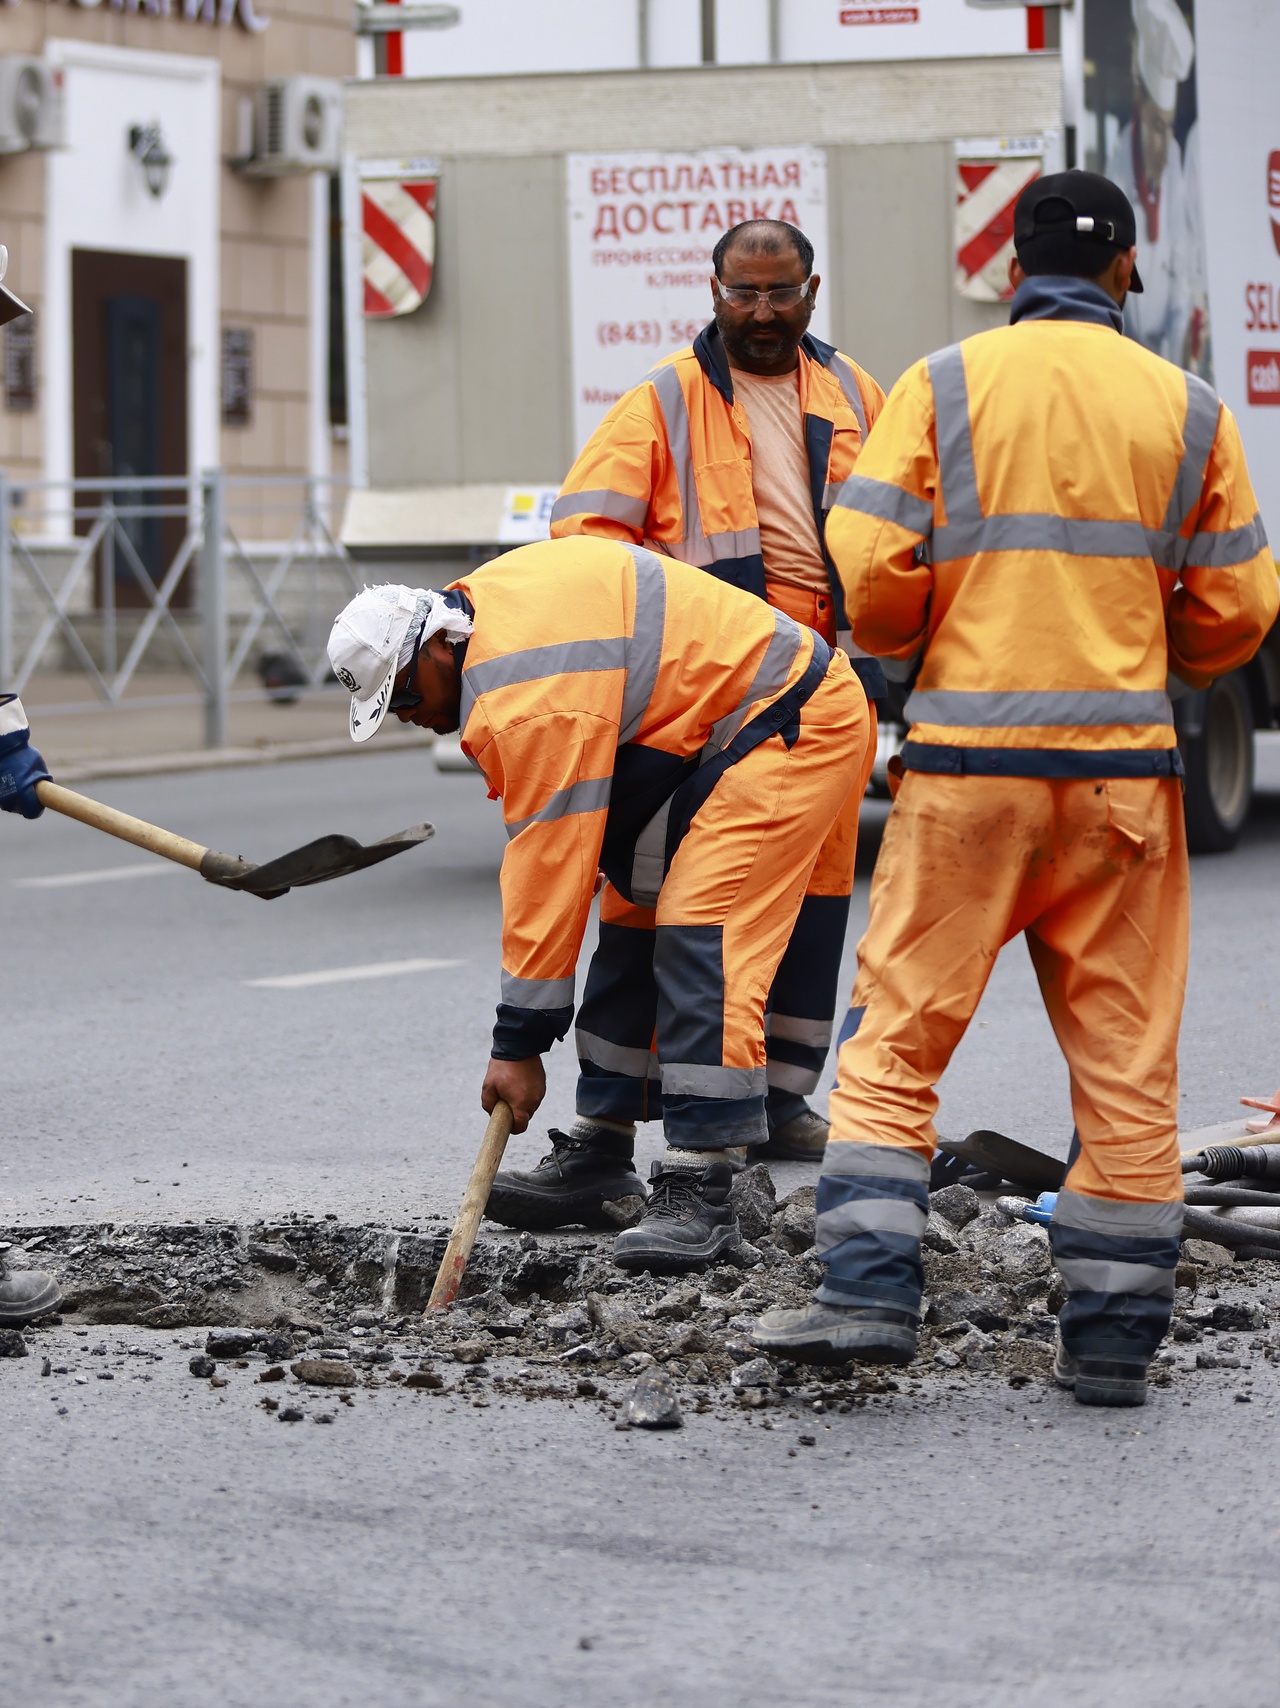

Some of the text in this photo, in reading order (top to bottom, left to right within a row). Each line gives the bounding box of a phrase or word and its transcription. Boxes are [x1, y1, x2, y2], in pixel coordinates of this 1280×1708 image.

[590, 161, 801, 195] БЕСПЛАТНАЯ
[592, 199, 801, 242] ДОСТАВКА
[592, 247, 713, 266] ПРОФЕССИО
[646, 270, 710, 288] КЛИЕН
[596, 318, 663, 349] (843)
